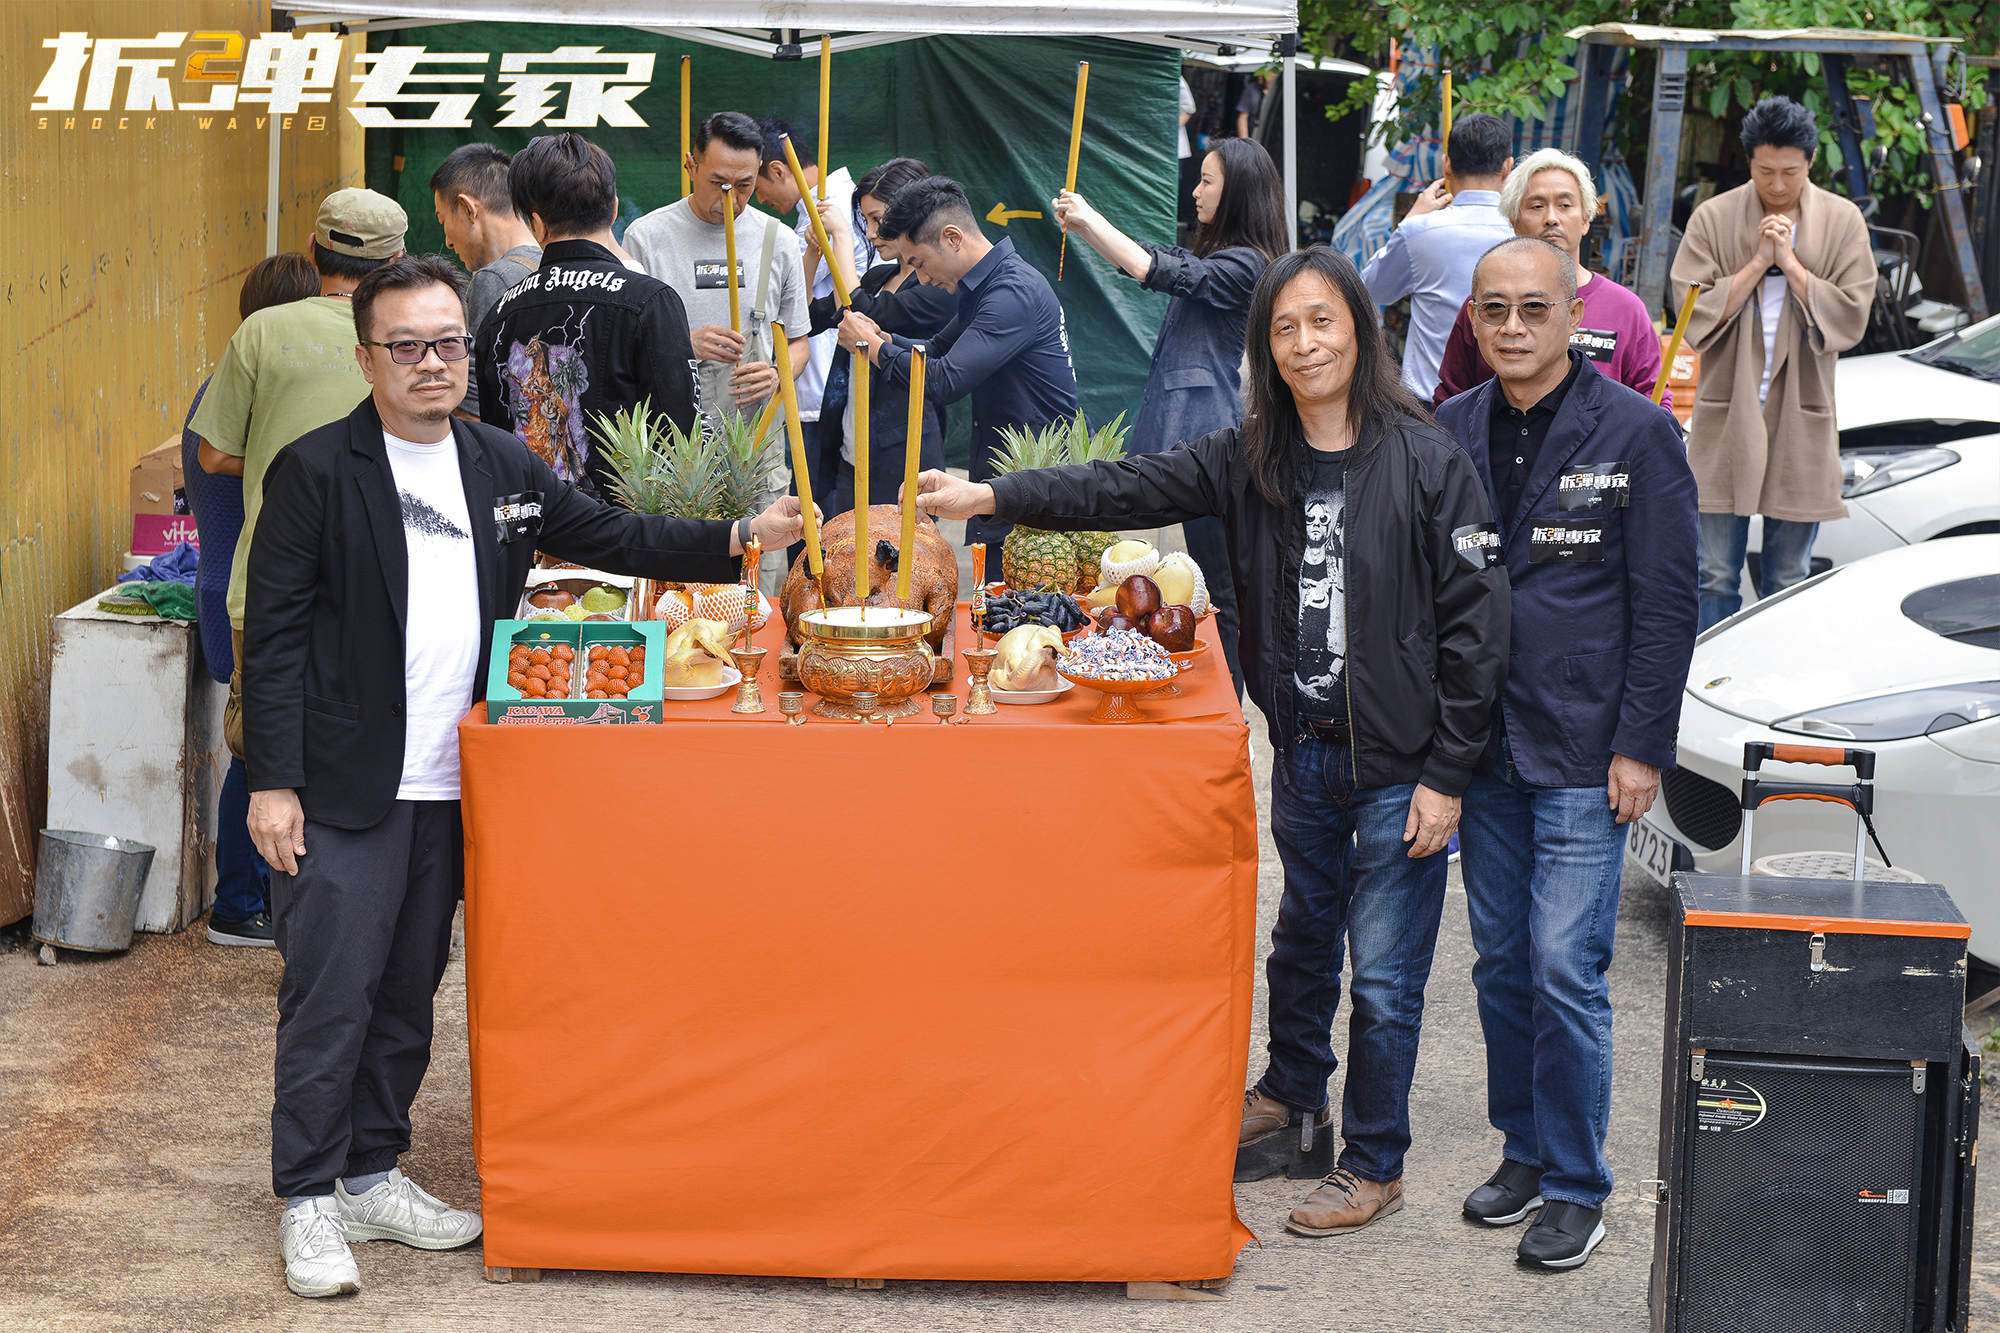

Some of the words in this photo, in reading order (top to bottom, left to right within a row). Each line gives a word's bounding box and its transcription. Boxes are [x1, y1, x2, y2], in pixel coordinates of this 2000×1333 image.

[544, 266, 627, 293] Angels
[281, 342, 357, 361] SNI
[498, 715, 575, 725] Strawberry
[506, 706, 566, 716] KAGAWA
[1630, 820, 1668, 877] 8723
